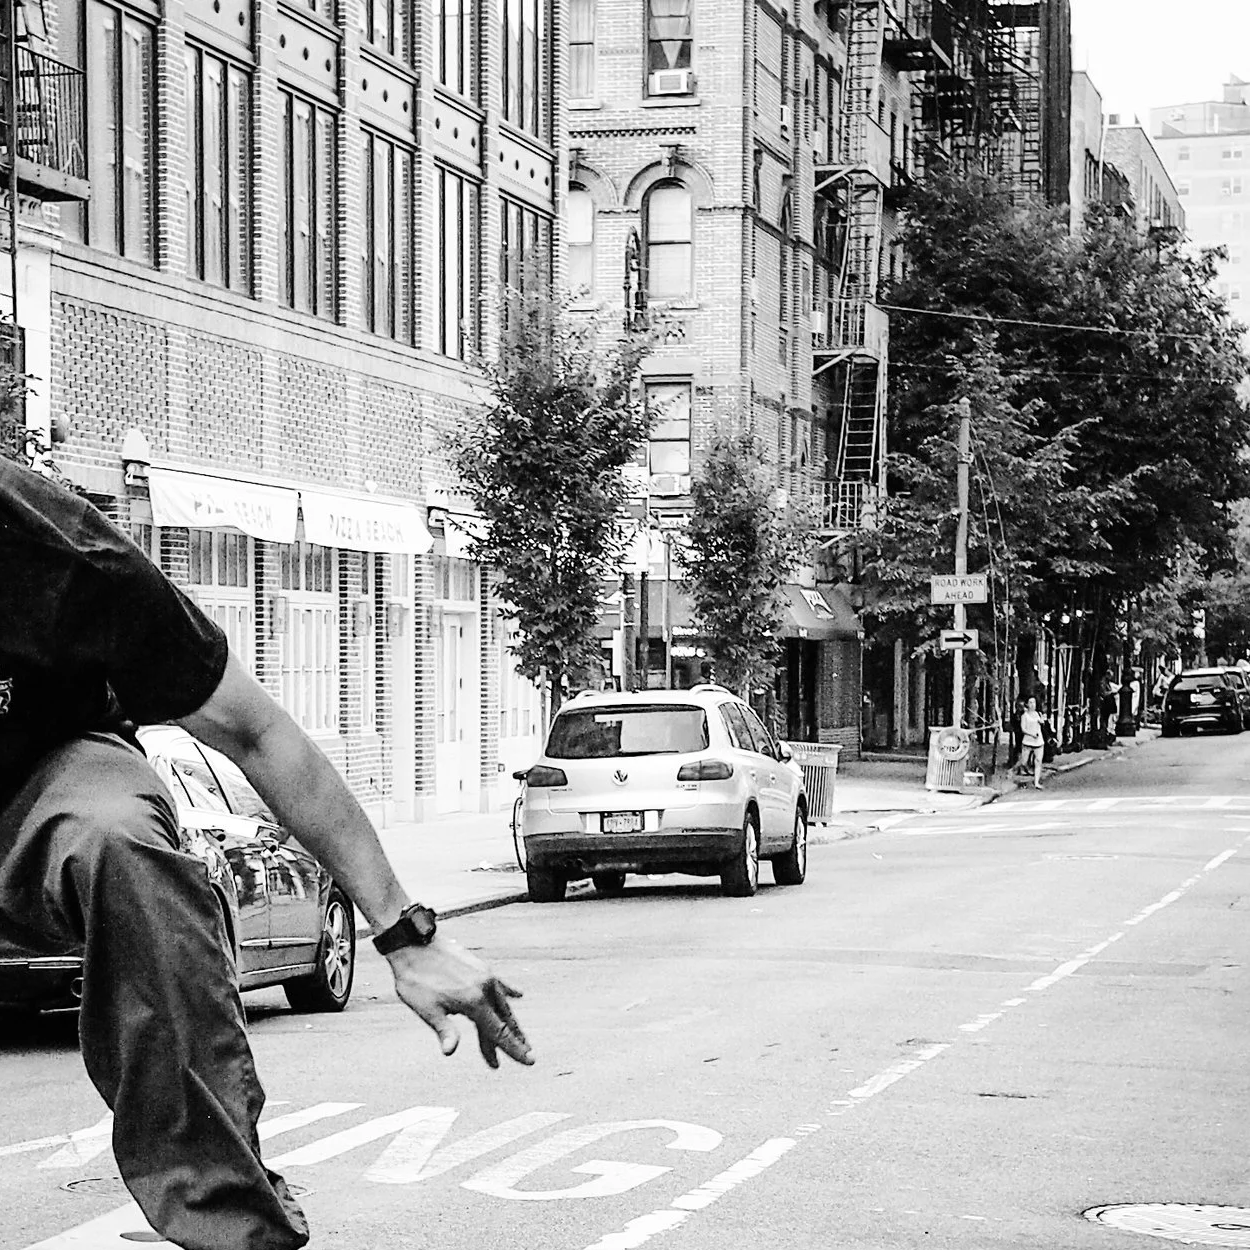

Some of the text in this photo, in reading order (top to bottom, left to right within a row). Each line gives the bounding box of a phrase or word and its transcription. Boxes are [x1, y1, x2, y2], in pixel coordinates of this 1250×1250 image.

[934, 578, 984, 587] ROAD WORK
[945, 591, 974, 600] AHEAD
